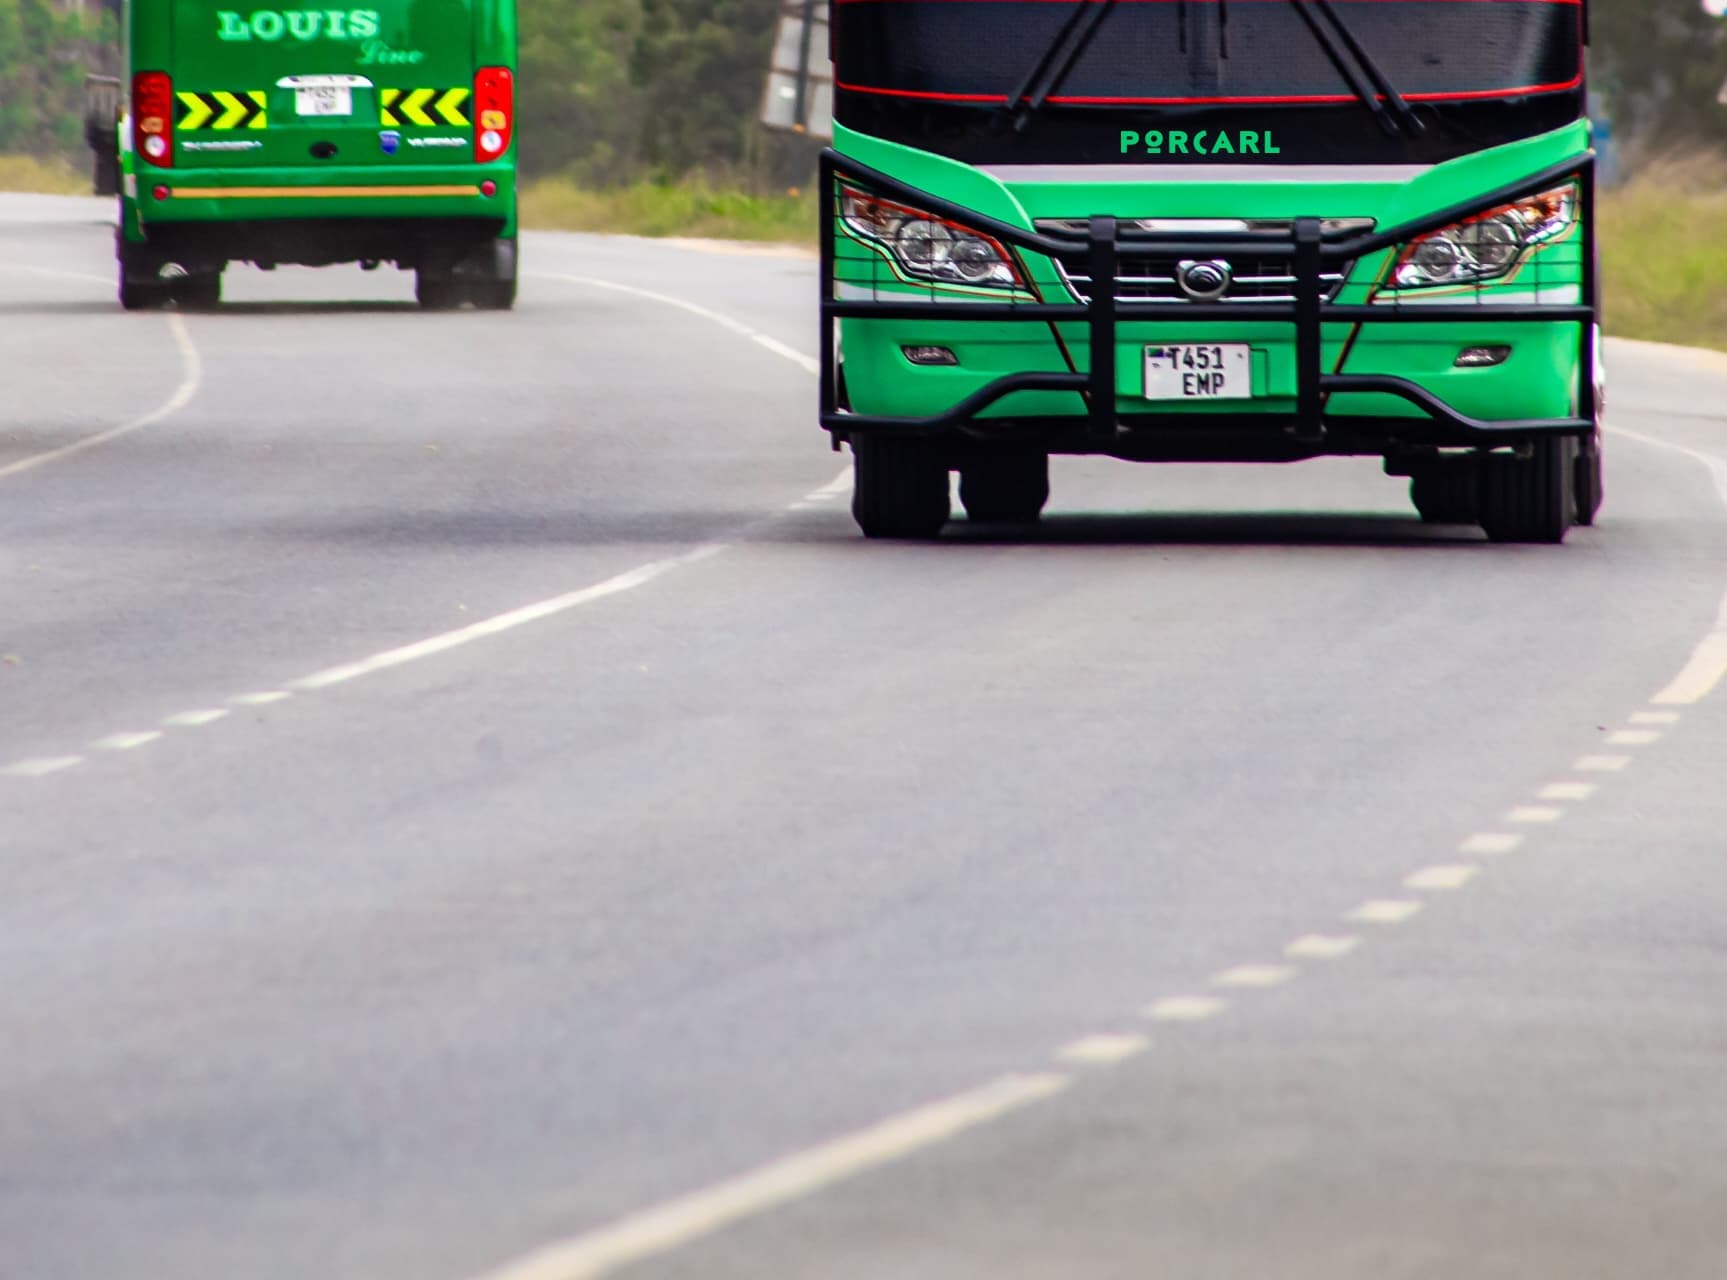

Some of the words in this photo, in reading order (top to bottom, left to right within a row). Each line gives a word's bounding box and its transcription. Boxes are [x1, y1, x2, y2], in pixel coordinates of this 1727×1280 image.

[216, 9, 381, 41] LOUIS
[1120, 130, 1281, 155] PORCARL
[1168, 346, 1225, 370] T451
[1182, 372, 1225, 396] EMP
